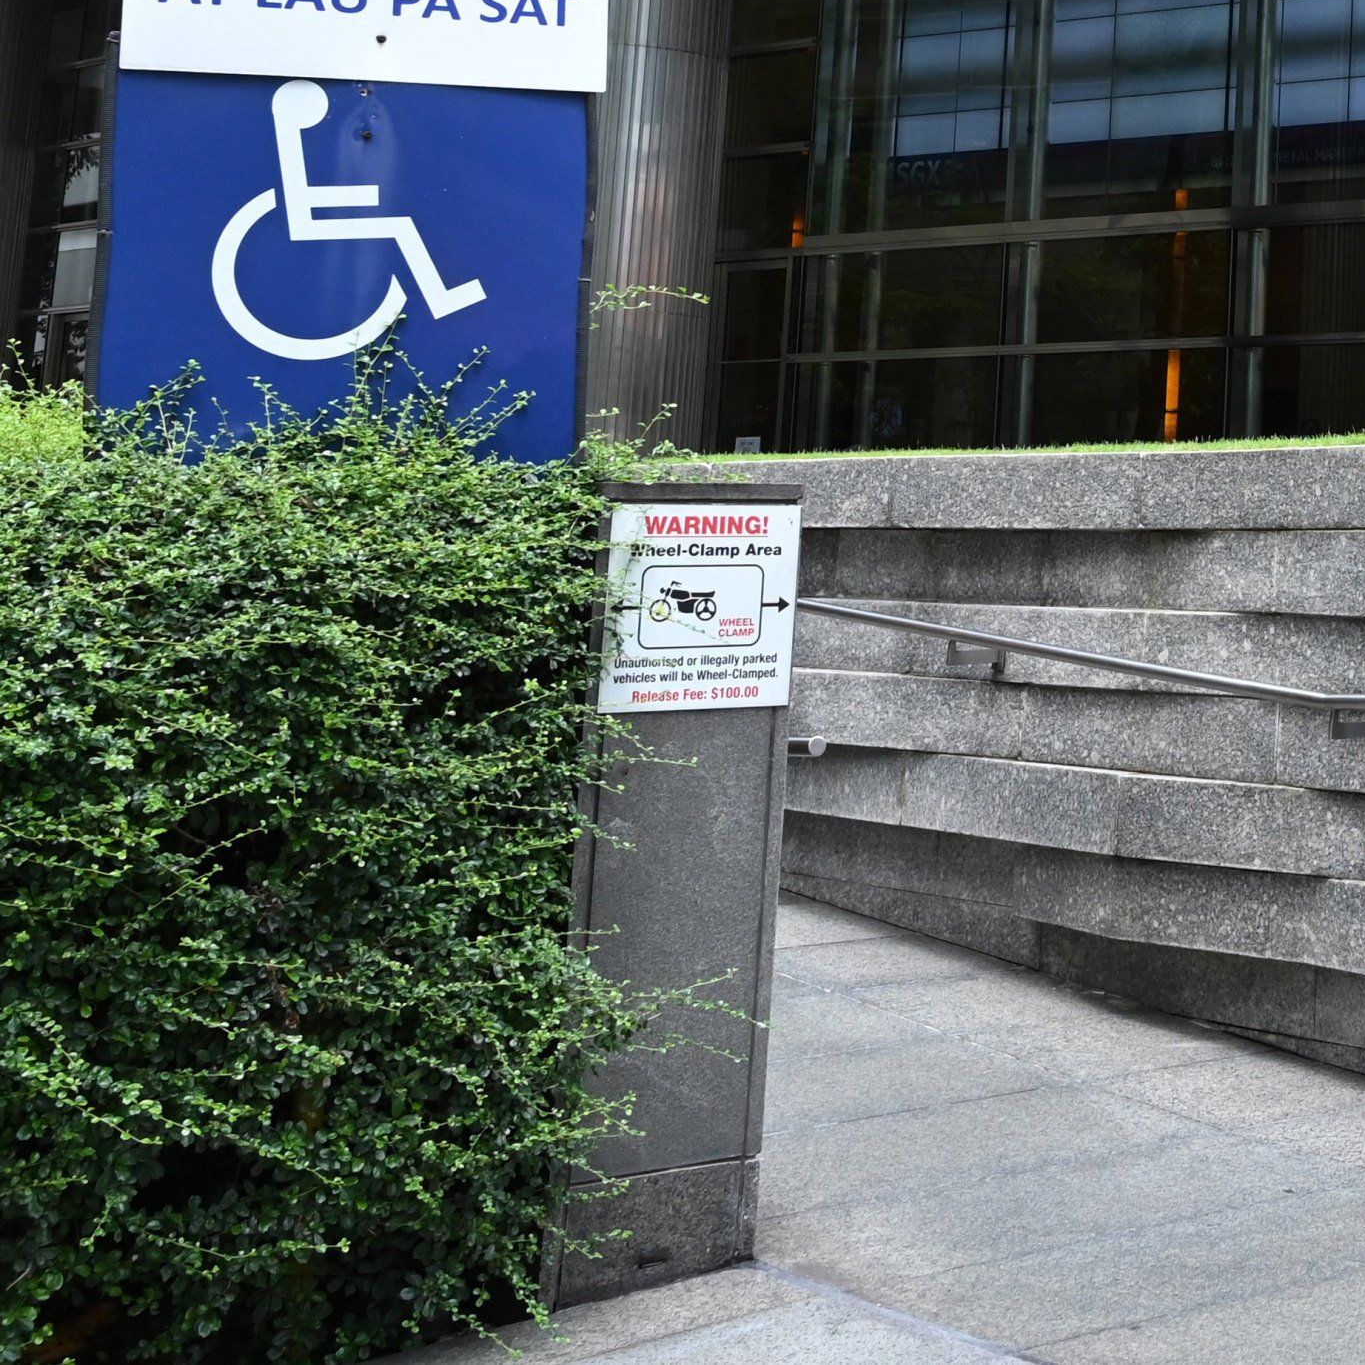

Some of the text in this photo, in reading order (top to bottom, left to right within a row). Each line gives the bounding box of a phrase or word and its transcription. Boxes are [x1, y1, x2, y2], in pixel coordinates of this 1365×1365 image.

[896, 159, 942, 188] SGX
[645, 516, 769, 535] WARNING!
[630, 543, 782, 559] Wheel-Clamp Area
[719, 618, 755, 627] WHEEL
[718, 628, 755, 637] CLAMP
[614, 653, 778, 669] Unauthorised or illegally parked
[613, 668, 779, 684] vehicles will be Wheel-Clamped.
[632, 686, 759, 703] Release Fee: $100.00
